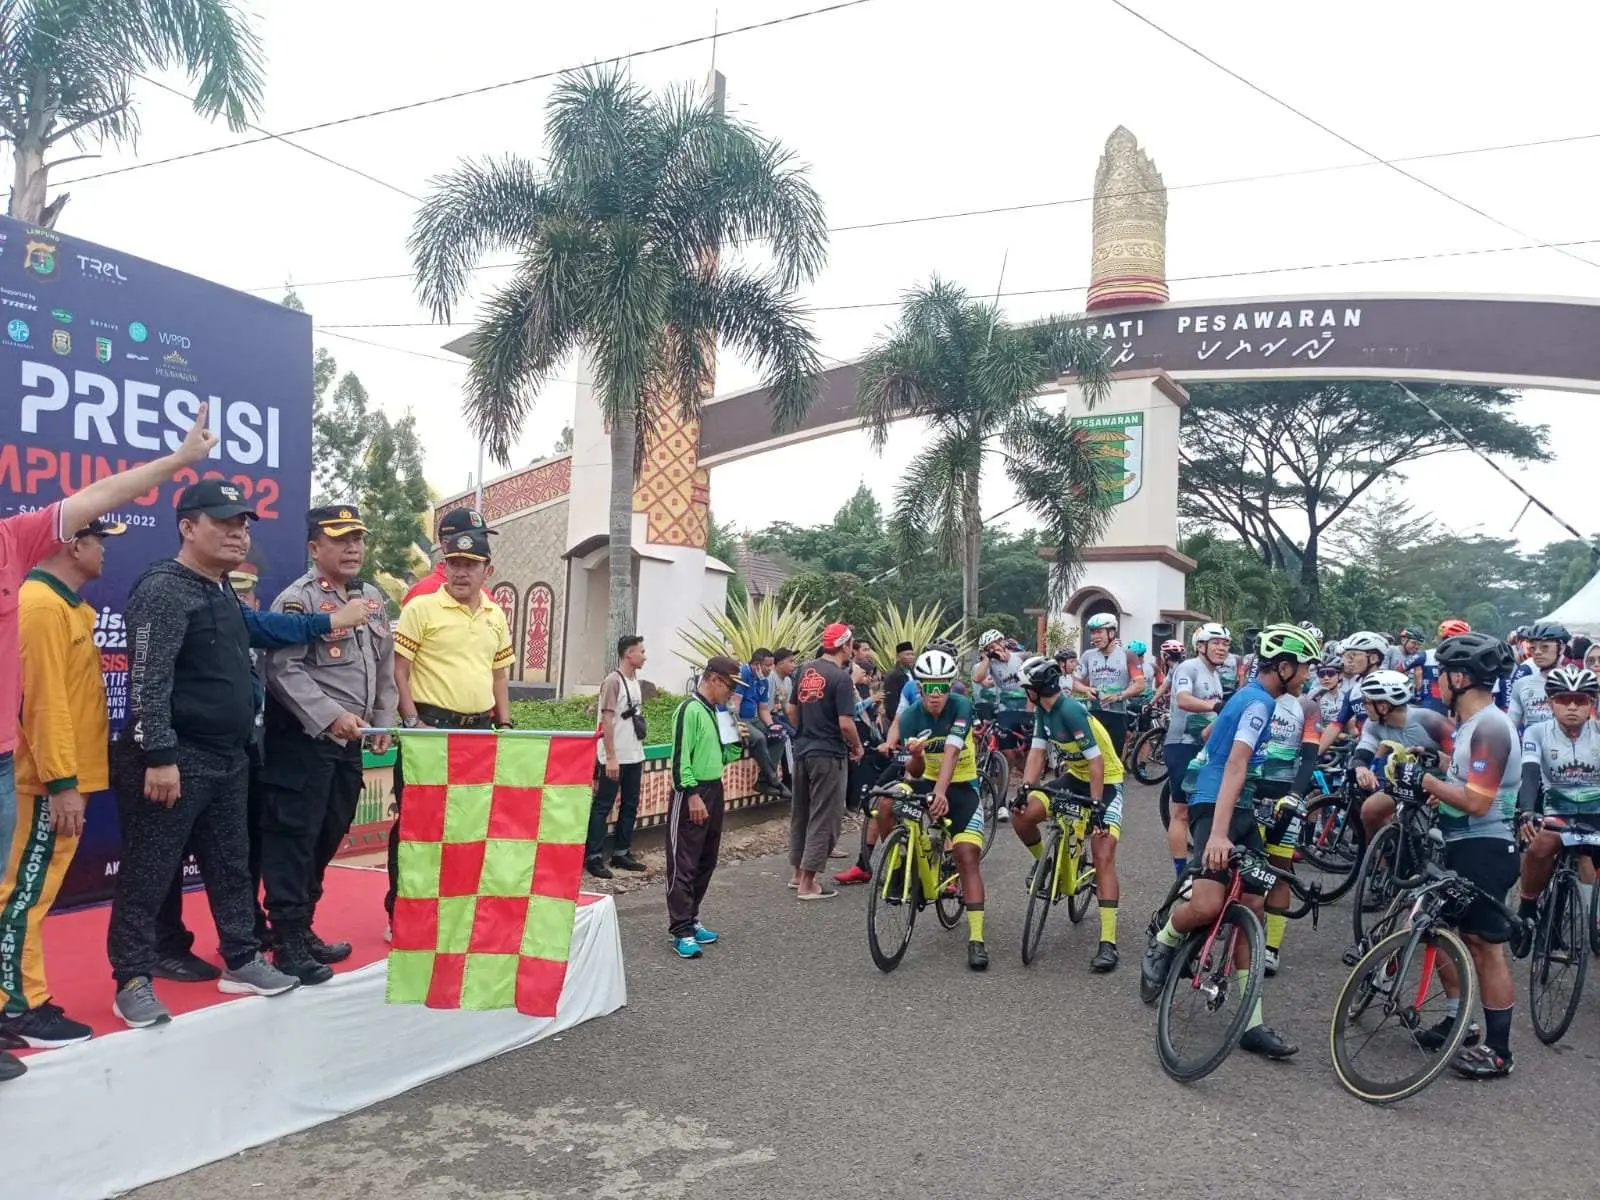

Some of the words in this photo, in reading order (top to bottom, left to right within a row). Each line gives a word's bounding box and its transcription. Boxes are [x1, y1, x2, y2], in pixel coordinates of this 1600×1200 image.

[1178, 308, 1362, 334] PESAWARAN
[20, 360, 280, 468] PRESISI
[1076, 415, 1139, 427] PESAWARAN
[172, 467, 279, 519] 222
[125, 514, 156, 527] 2022
[11, 844, 45, 919] PROVINSI
[1251, 867, 1277, 885] 3168
